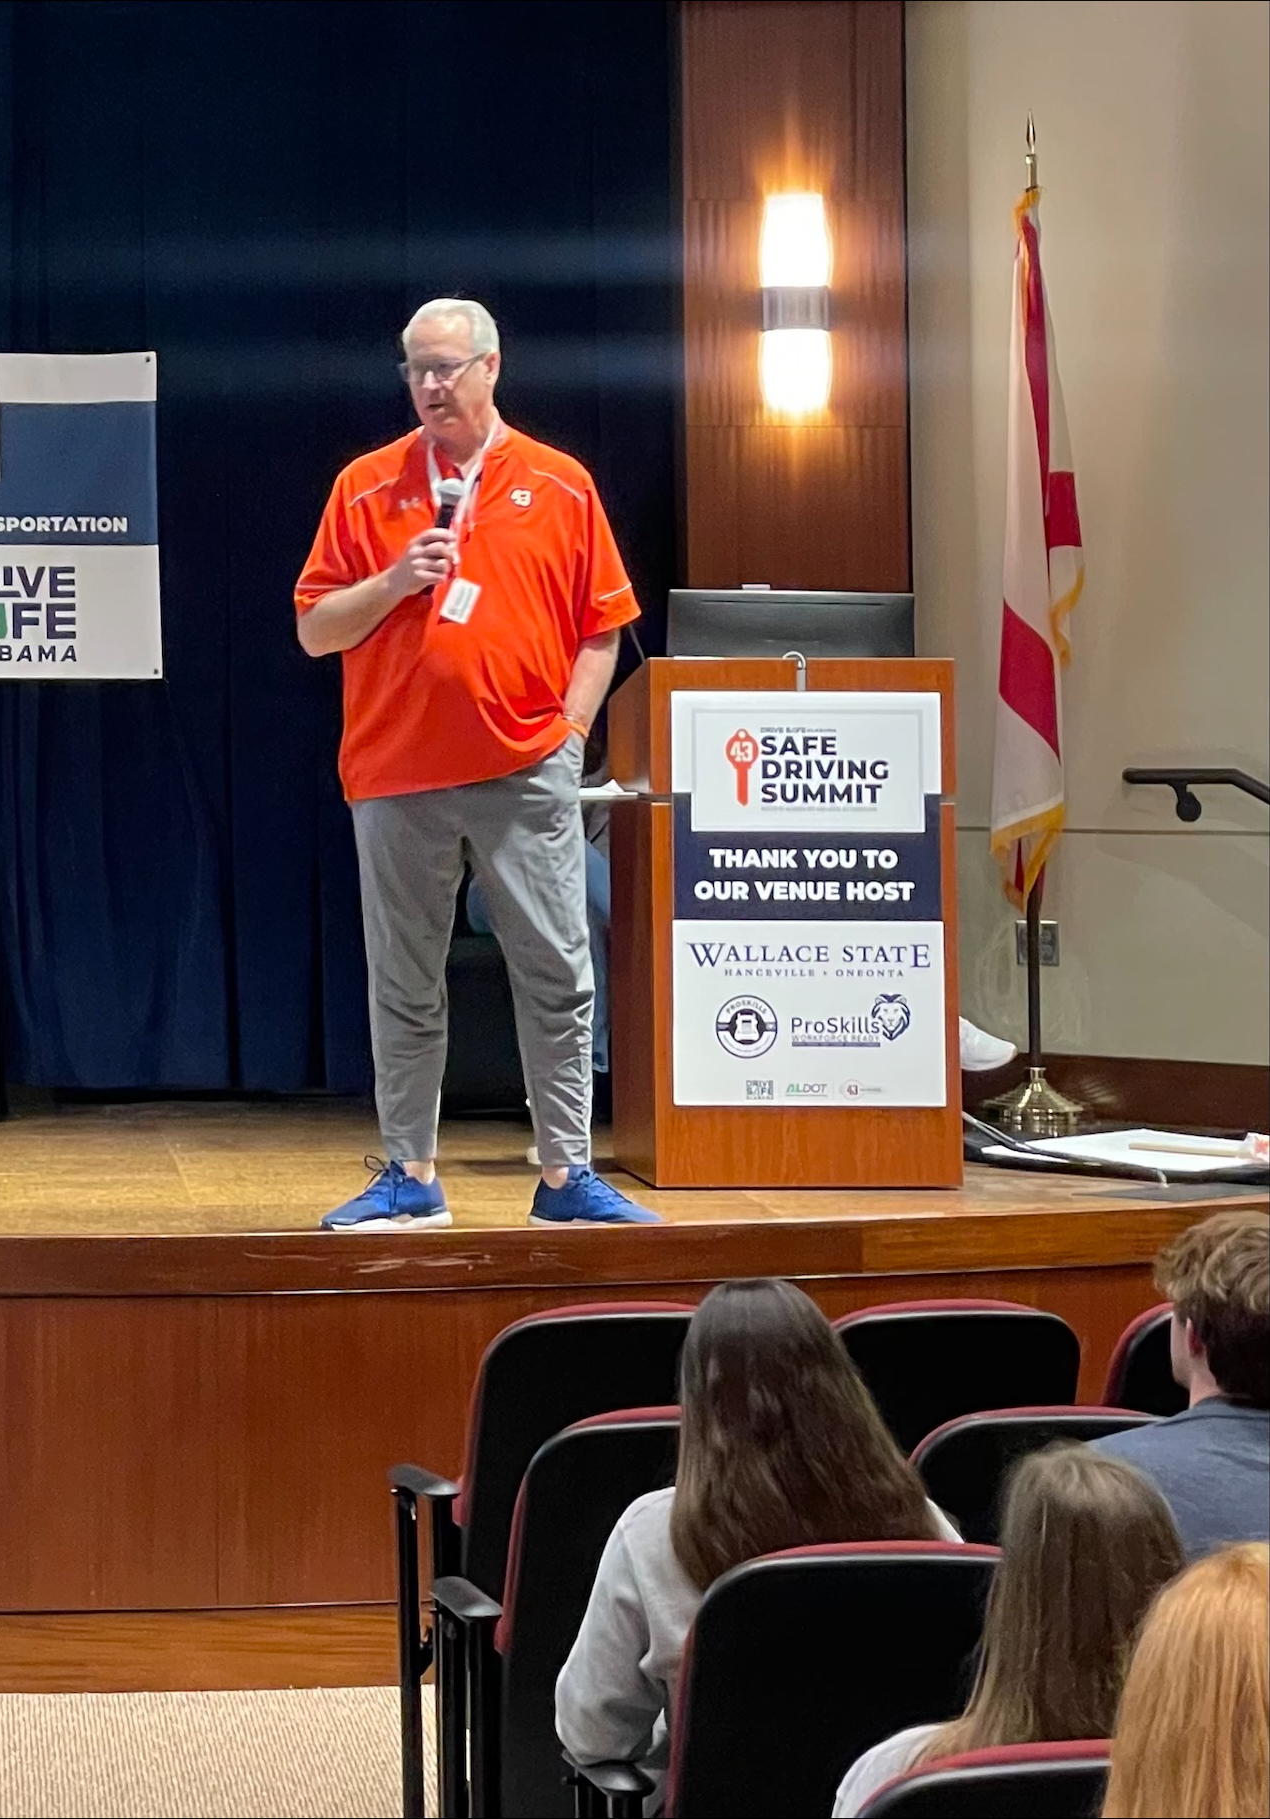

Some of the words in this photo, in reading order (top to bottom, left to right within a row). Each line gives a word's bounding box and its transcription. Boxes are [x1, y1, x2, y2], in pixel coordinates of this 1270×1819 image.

[730, 741, 753, 762] 43
[760, 736, 837, 756] SAFE
[761, 760, 889, 780] DRIVING
[761, 783, 882, 804] SUMMIT
[709, 848, 798, 869] THANK
[803, 848, 857, 869] YOU
[863, 848, 899, 869] TO
[694, 881, 749, 902] OUR
[754, 881, 841, 902] VENUE
[846, 881, 915, 902] HOST
[686, 943, 829, 968] WALLACE
[842, 944, 931, 969] STATE
[724, 969, 816, 977] HANCEVILLE
[835, 969, 905, 977] ONEONTA
[725, 999, 768, 1014] PROSKILLS
[791, 1017, 880, 1034] ProSkills
[786, 1083, 828, 1093] ALDOT
